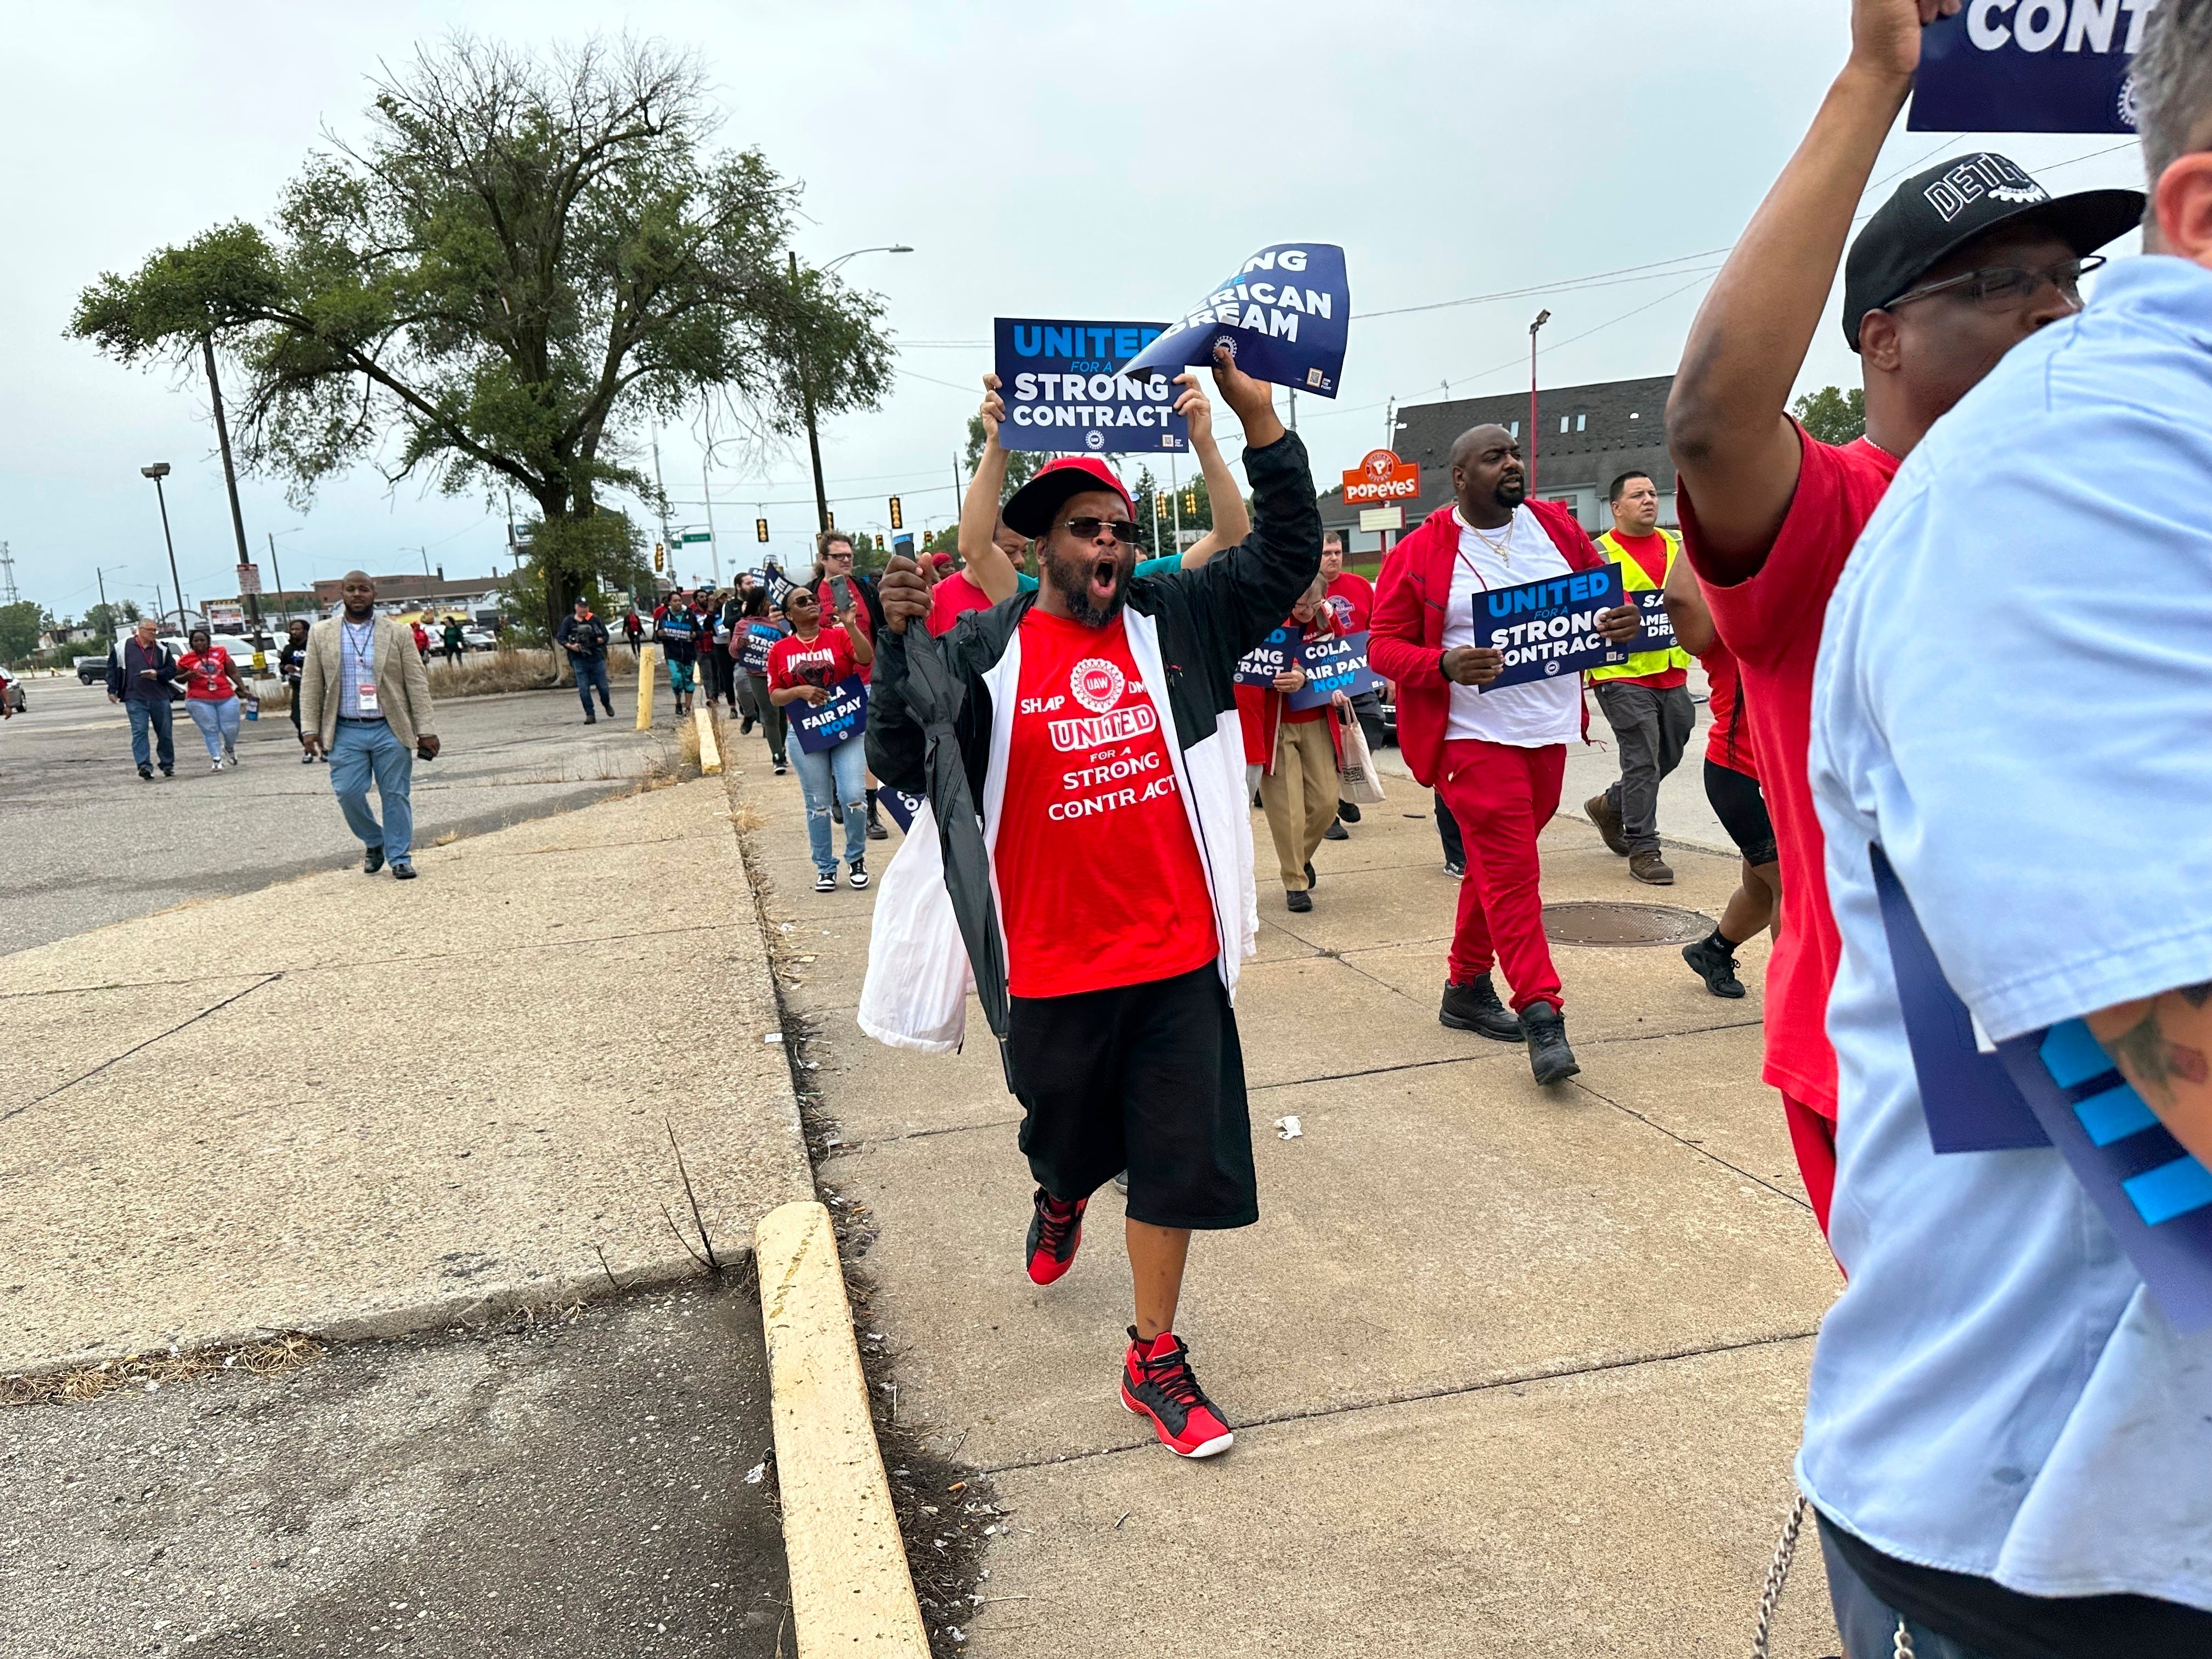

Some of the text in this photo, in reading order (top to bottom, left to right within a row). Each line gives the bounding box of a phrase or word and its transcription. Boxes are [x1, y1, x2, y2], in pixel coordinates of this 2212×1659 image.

[1218, 274, 1246, 290] HE
[1161, 302, 1299, 343] DREAM
[1071, 361, 1113, 373] FOR A
[1014, 373, 1169, 402] STRONG
[1013, 405, 1173, 427] CONTRACT
[1488, 572, 1610, 618] UNITED
[1534, 606, 1568, 620] FOR A
[1639, 613, 1671, 627] AME
[1305, 640, 1352, 659] COLA
[1321, 655, 1339, 664] AND
[1491, 633, 1612, 668] ONTRAC
[786, 648, 835, 673] UNION
[1237, 661, 1284, 676] RACT
[1305, 654, 1368, 680] AIR PAY
[1086, 676, 1108, 691] UAW
[1312, 672, 1356, 692] NOW
[802, 696, 861, 730] FAIR PAY
[823, 701, 838, 710] AND
[1020, 695, 1065, 714] SHAP
[819, 713, 855, 737] NOW
[1049, 705, 1154, 750] UNITED
[1090, 746, 1132, 763] FOR A
[1063, 751, 1160, 790] STRONG
[1048, 774, 1177, 821] CONTRACT
